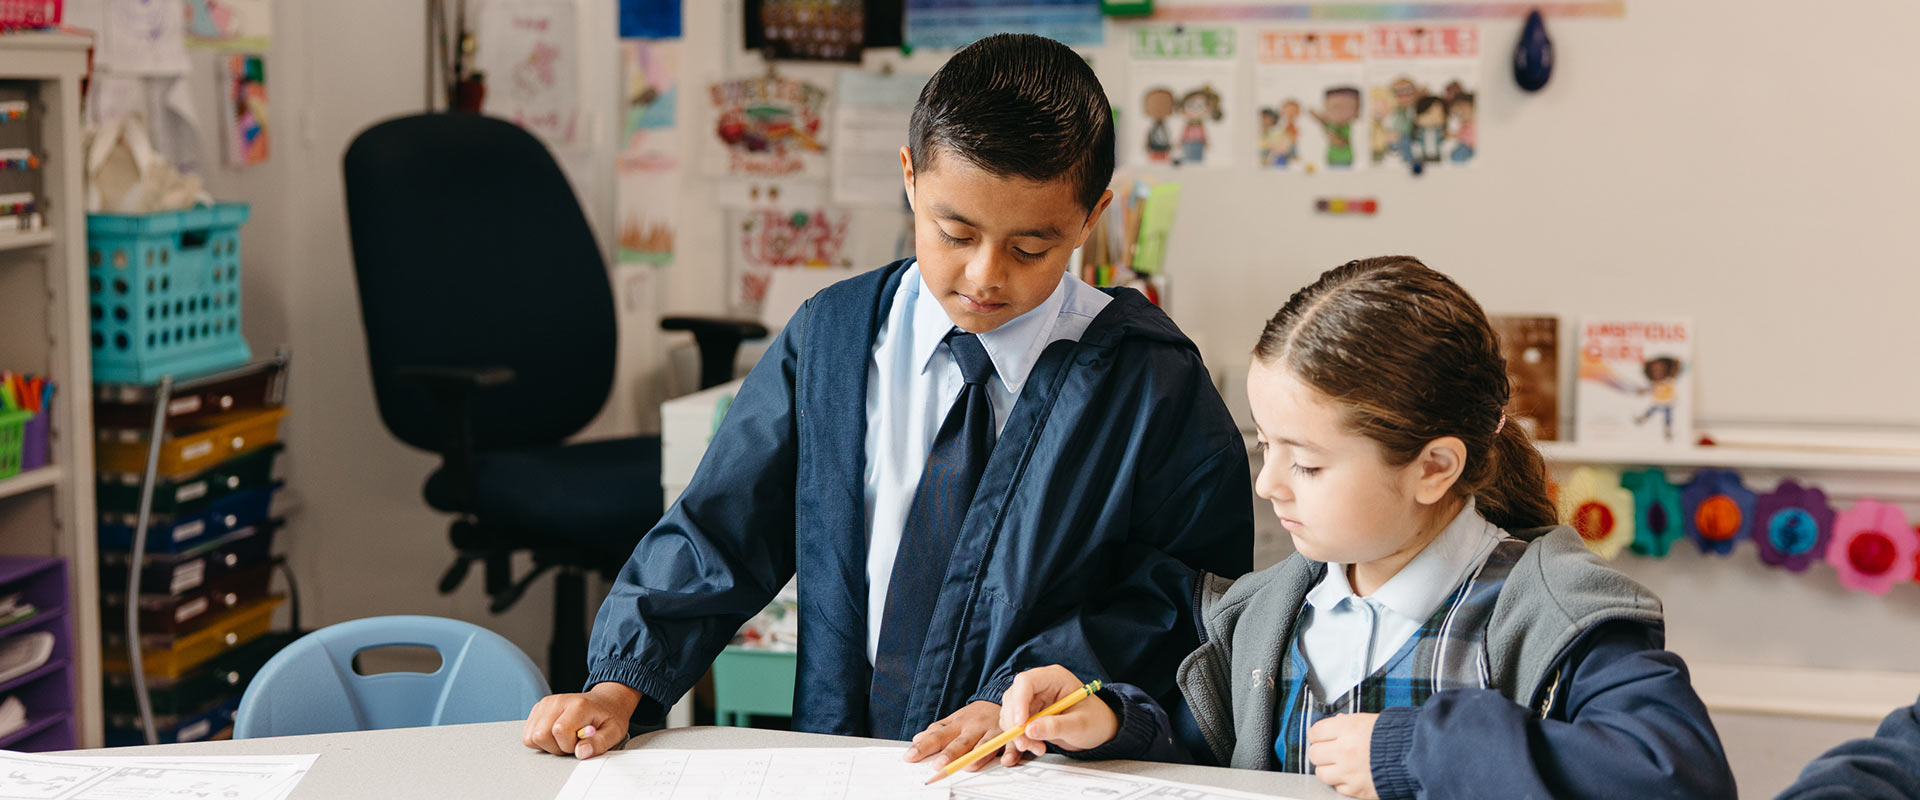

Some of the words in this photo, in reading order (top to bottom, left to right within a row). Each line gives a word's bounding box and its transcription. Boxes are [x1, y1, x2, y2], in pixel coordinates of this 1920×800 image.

[1129, 29, 1202, 57] LEVEL
[1257, 33, 1332, 61] LEVEL
[1369, 26, 1445, 55] LEVEL
